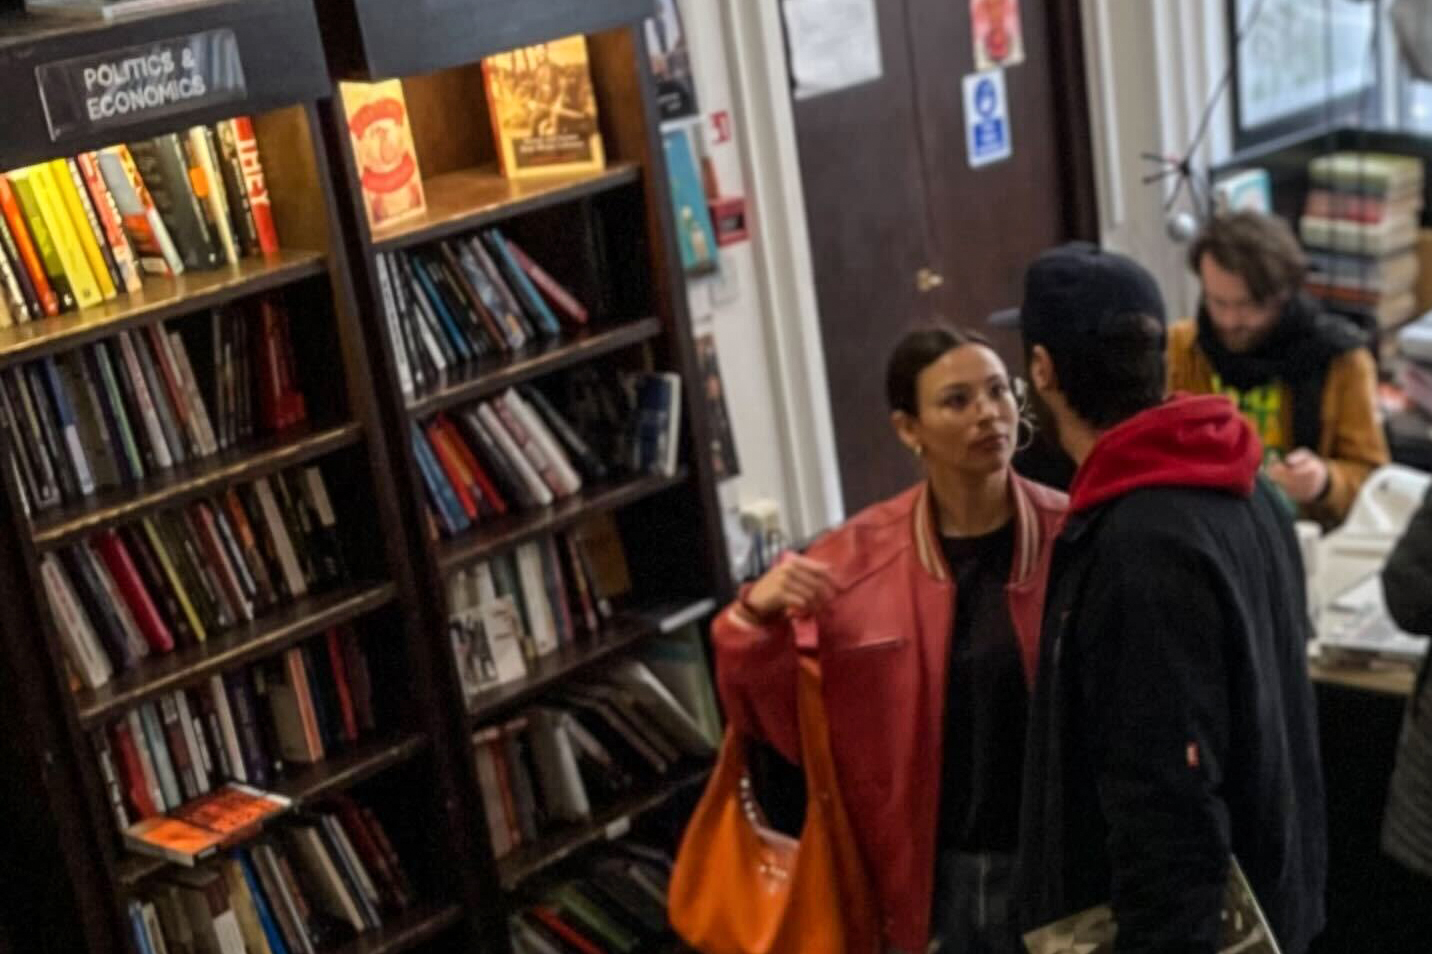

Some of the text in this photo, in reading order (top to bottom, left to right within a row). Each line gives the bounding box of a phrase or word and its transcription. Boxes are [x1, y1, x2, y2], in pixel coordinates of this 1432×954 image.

[84, 47, 195, 91] POLITICS &
[87, 74, 206, 121] ECONOMICS
